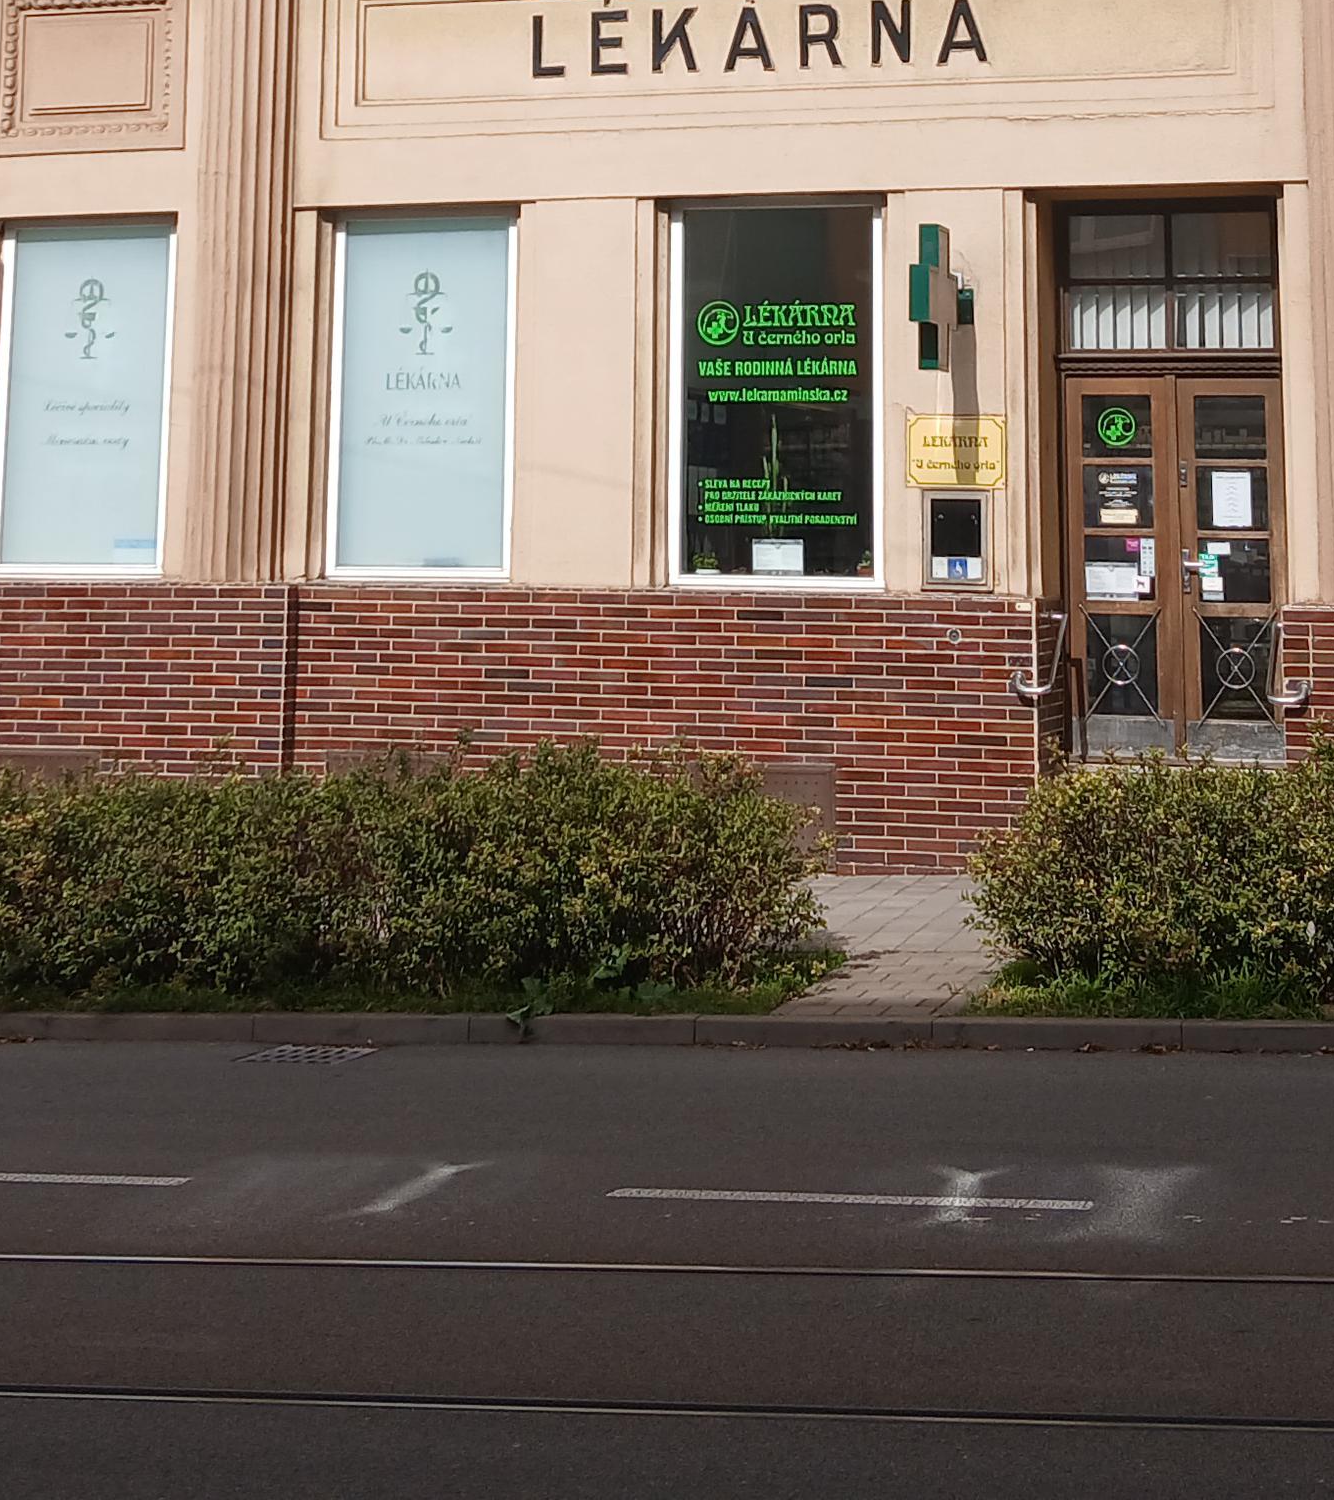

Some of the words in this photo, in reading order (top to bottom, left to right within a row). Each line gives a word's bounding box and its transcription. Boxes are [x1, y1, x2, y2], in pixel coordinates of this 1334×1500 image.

[743, 300, 856, 327] LÉKÁRNA
[743, 330, 754, 345] U
[758, 330, 821, 345] černého
[824, 330, 856, 345] orla
[698, 358, 731, 377] VAŠE
[735, 357, 794, 376] RODINNÁ
[796, 356, 857, 376] LÉKÁRNA
